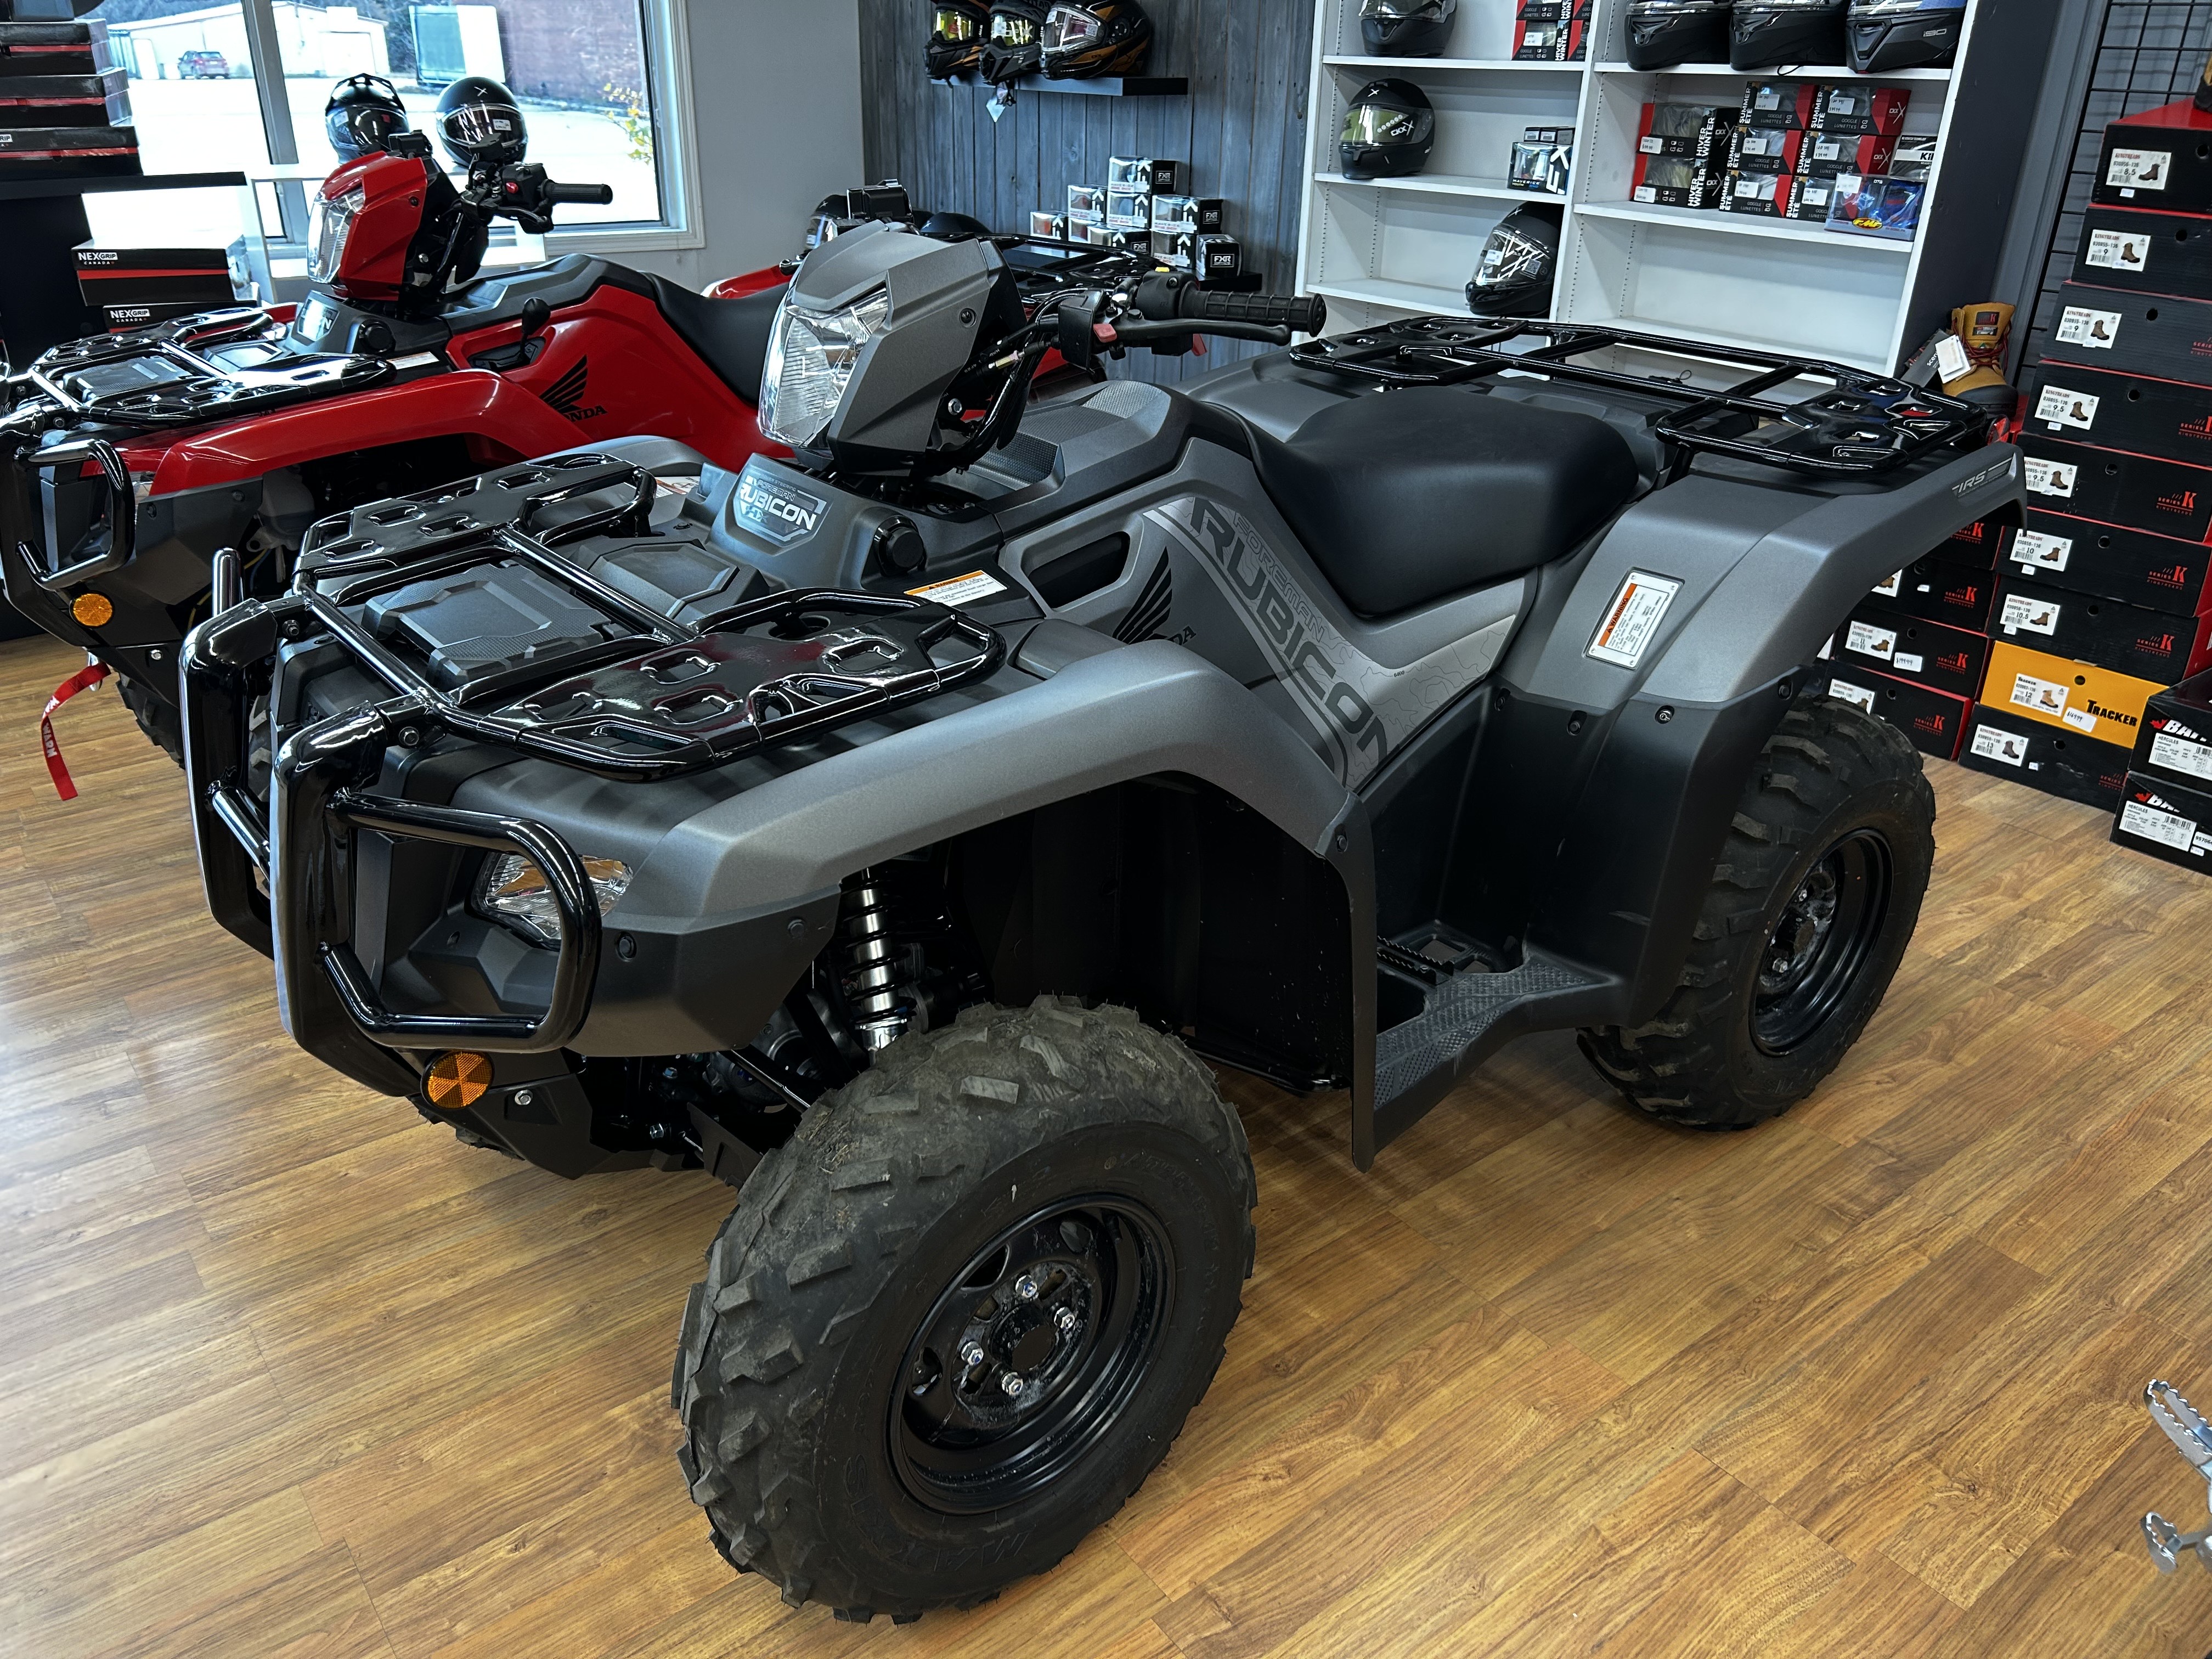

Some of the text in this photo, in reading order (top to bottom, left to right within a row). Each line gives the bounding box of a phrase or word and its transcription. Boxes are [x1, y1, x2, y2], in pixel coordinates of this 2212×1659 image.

[1560, 28, 1568, 61] WINTER
[1739, 87, 1751, 124] SUMMER
[1810, 92, 1824, 128] SUMMER
[1696, 127, 1707, 156] HIVER
[1702, 117, 1716, 157] WINTER
[1727, 132, 1739, 168] SUMMER
[1797, 137, 1809, 174] SUMMER
[1688, 178, 1698, 207] HIVER
[1693, 168, 1706, 207] WINTER
[1719, 175, 1731, 210] SUMMER
[1786, 182, 1799, 218] SUMMER
[1853, 219, 1882, 228] FMF
[2180, 422, 2203, 431] SERIES
[1957, 470, 1987, 493] IRS
[740, 483, 817, 531] RUBICON
[2158, 491, 2197, 509] SERIES K
[1972, 522, 1984, 538] K
[935, 579, 960, 588] WARNING
[1233, 511, 1325, 642] FOREMAN
[2149, 566, 2188, 583] SERIES K
[1965, 586, 1978, 602] K
[1609, 597, 1629, 627] WARNING
[2137, 634, 2175, 651] SERIES K
[1393, 670, 1406, 678] 6400
[1938, 653, 1968, 668] SERIES K
[1915, 714, 1945, 730] SERIES K
[2086, 699, 2138, 727] TRACKER
[2158, 736, 2179, 744] HERCULES
[2128, 804, 2148, 814] HERCULES
